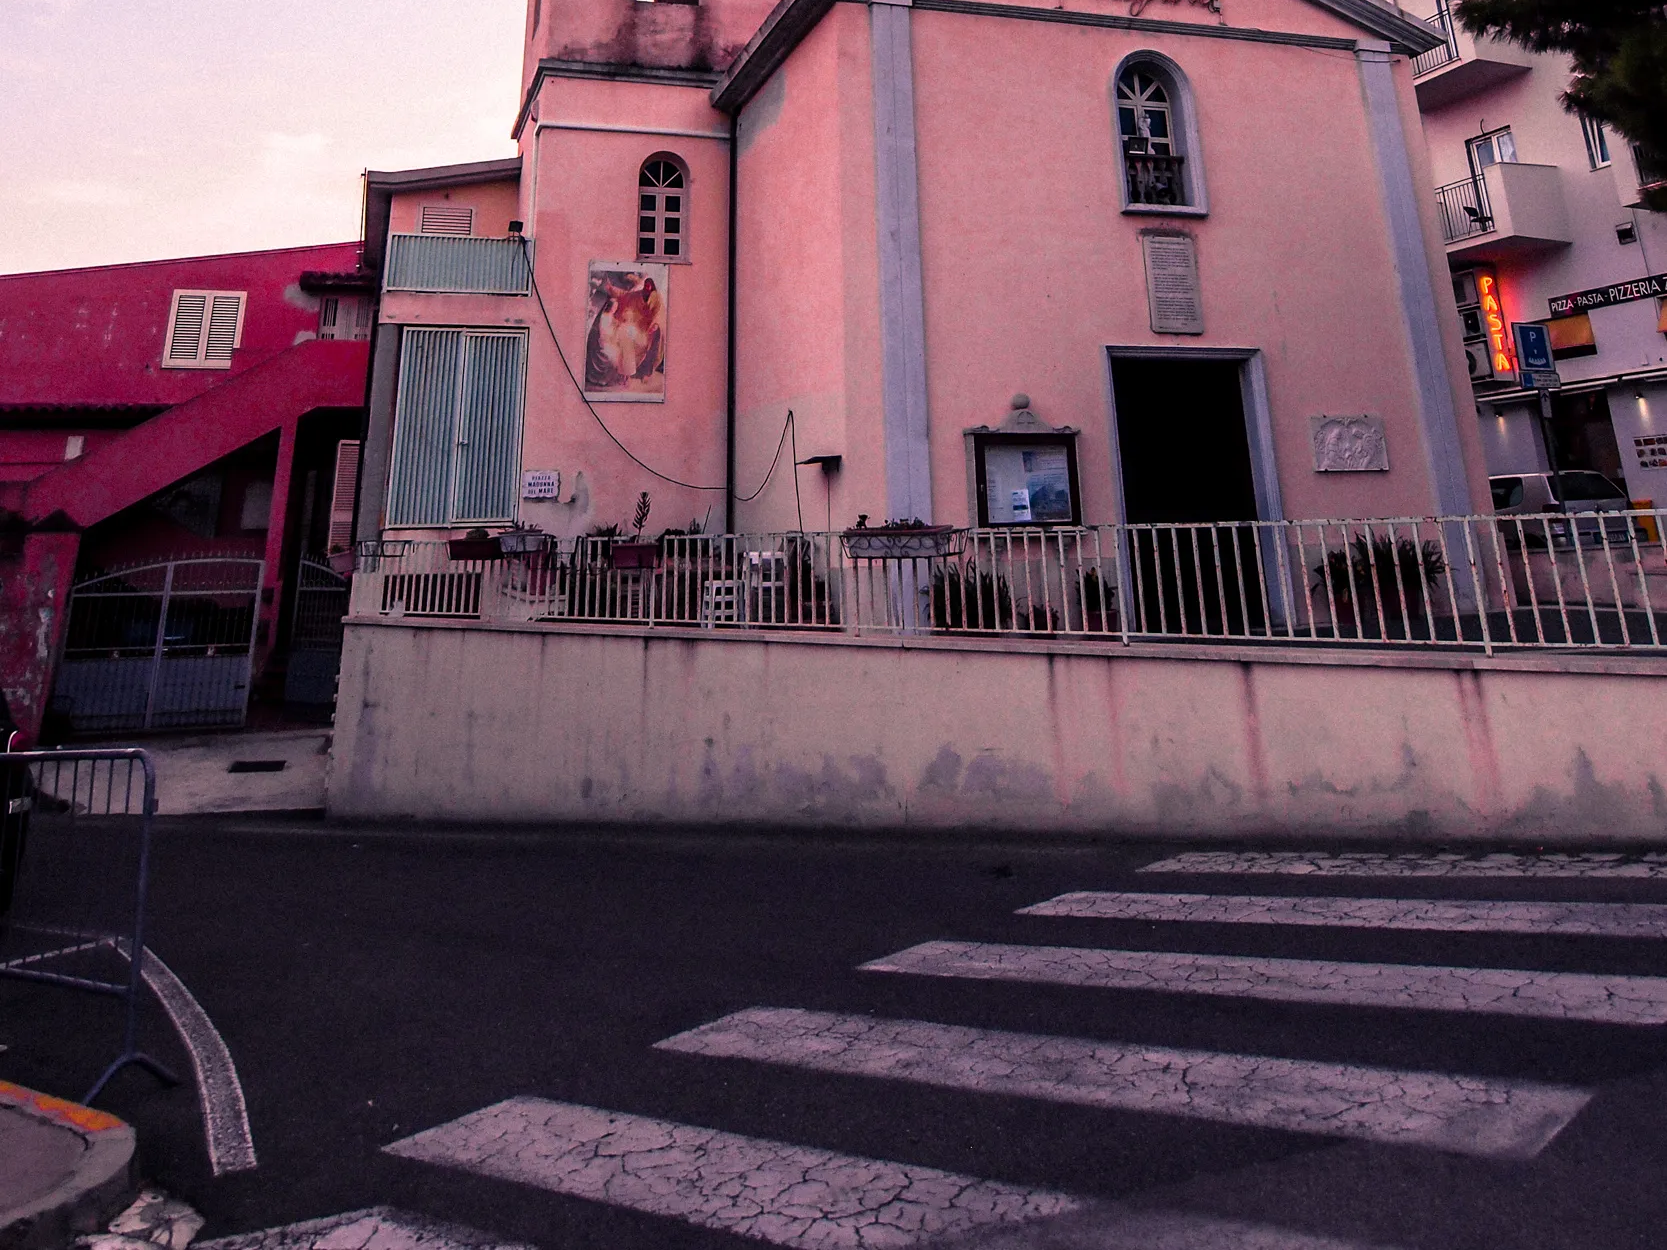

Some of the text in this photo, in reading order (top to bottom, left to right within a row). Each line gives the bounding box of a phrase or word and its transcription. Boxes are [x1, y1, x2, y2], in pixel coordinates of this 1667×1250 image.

[1551, 299, 1574, 312] PIZZA
[1577, 293, 1604, 307] PASTA
[1608, 279, 1661, 302] PIZZERIA
[1481, 276, 1510, 371] PASTA
[1529, 331, 1536, 342] P
